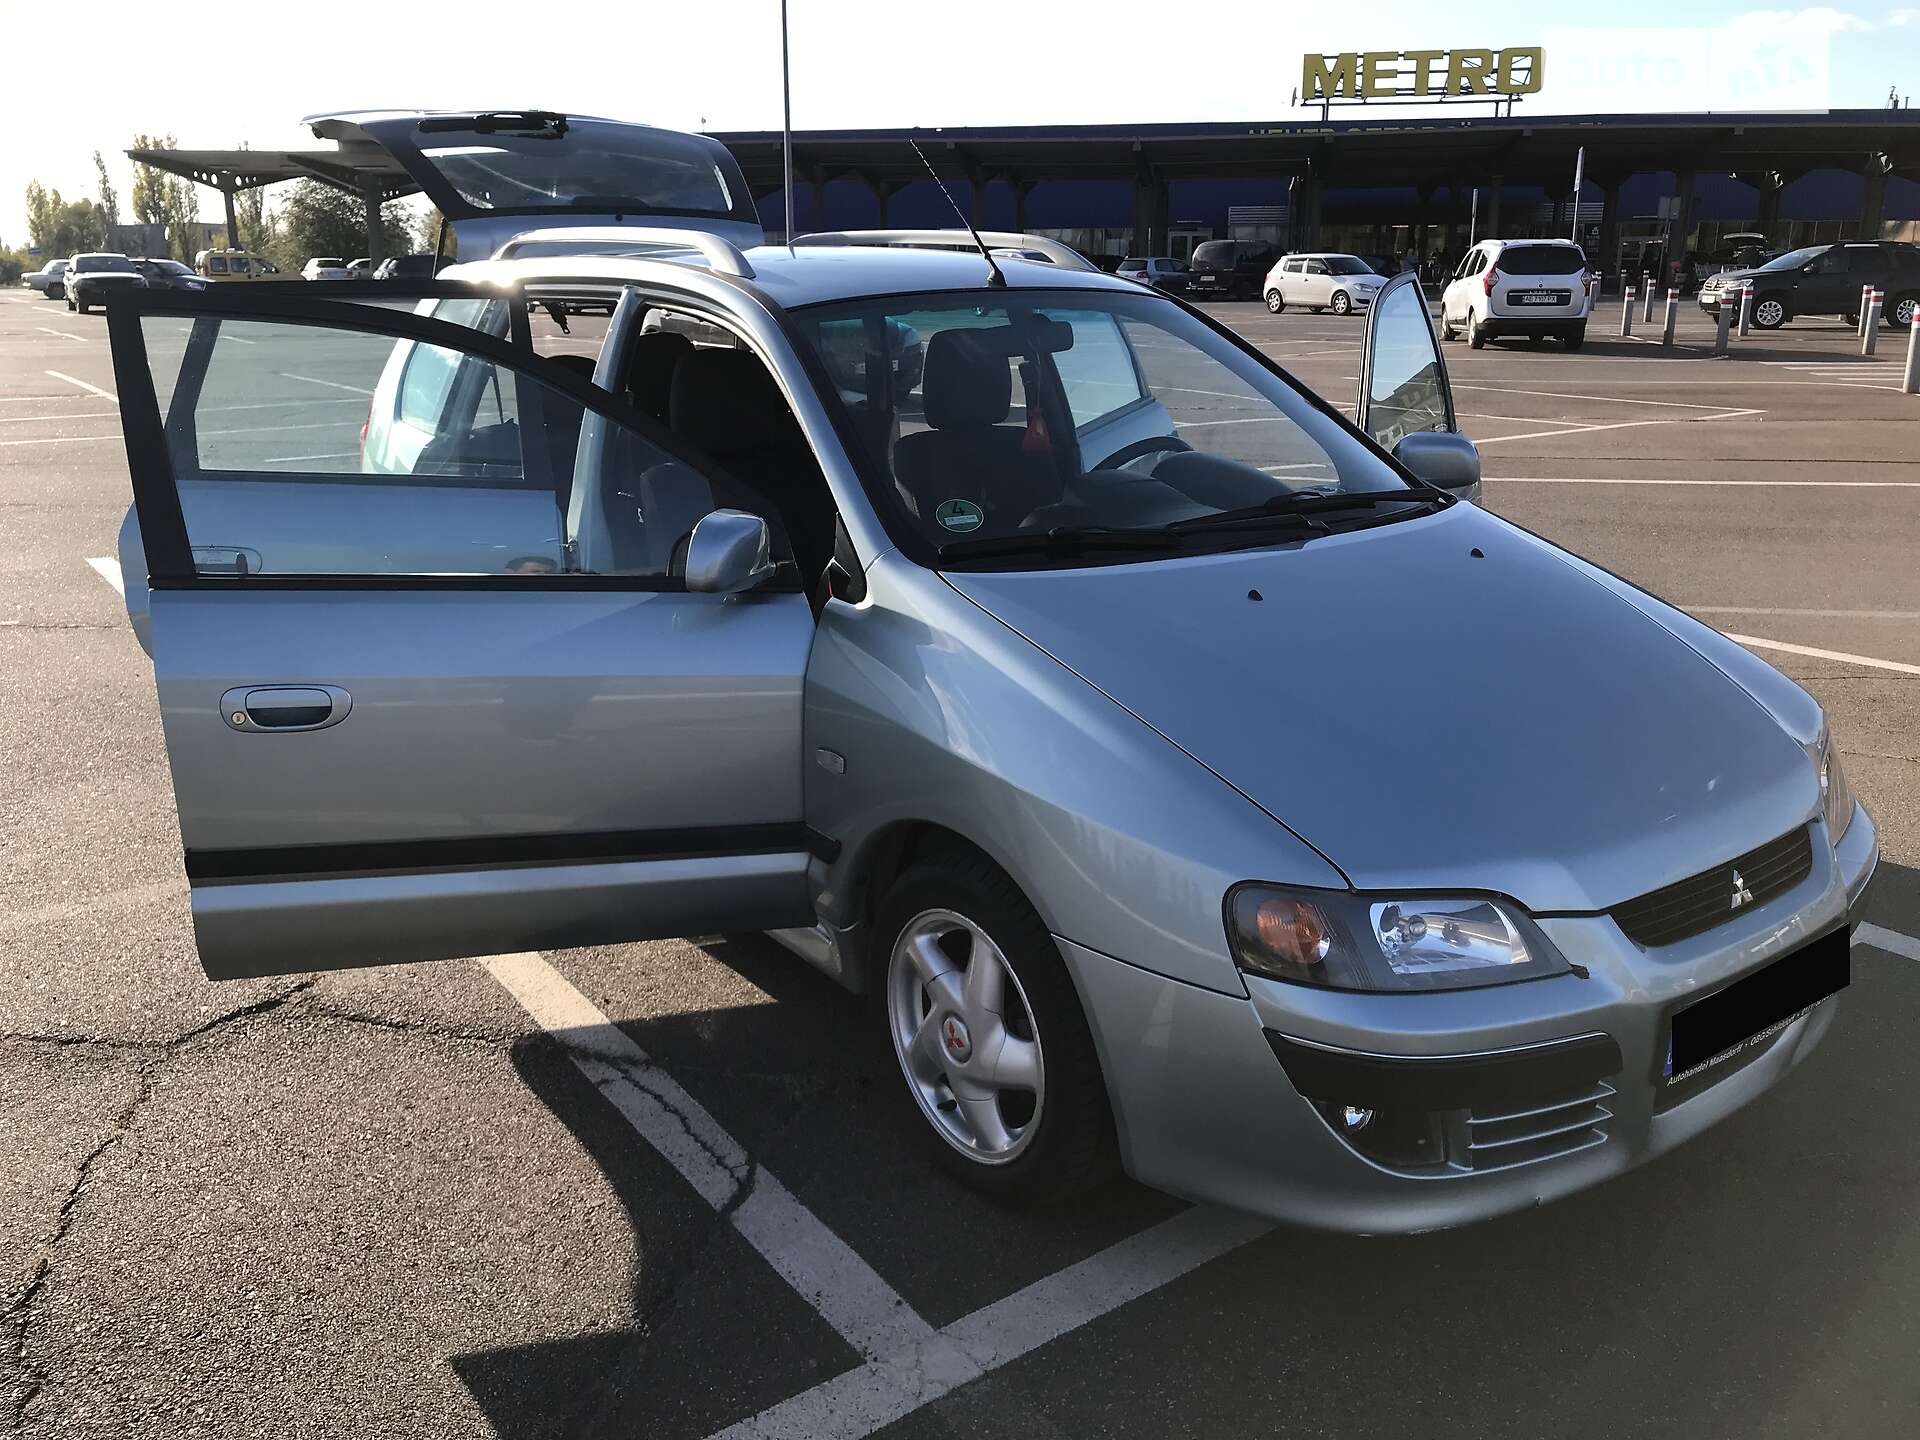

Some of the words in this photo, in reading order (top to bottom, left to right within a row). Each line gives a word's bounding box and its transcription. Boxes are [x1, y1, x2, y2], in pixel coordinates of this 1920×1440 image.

[1302, 47, 1546, 99] METRO
[952, 500, 965, 516] 4
[1666, 1060, 1709, 1087] Autohandel
